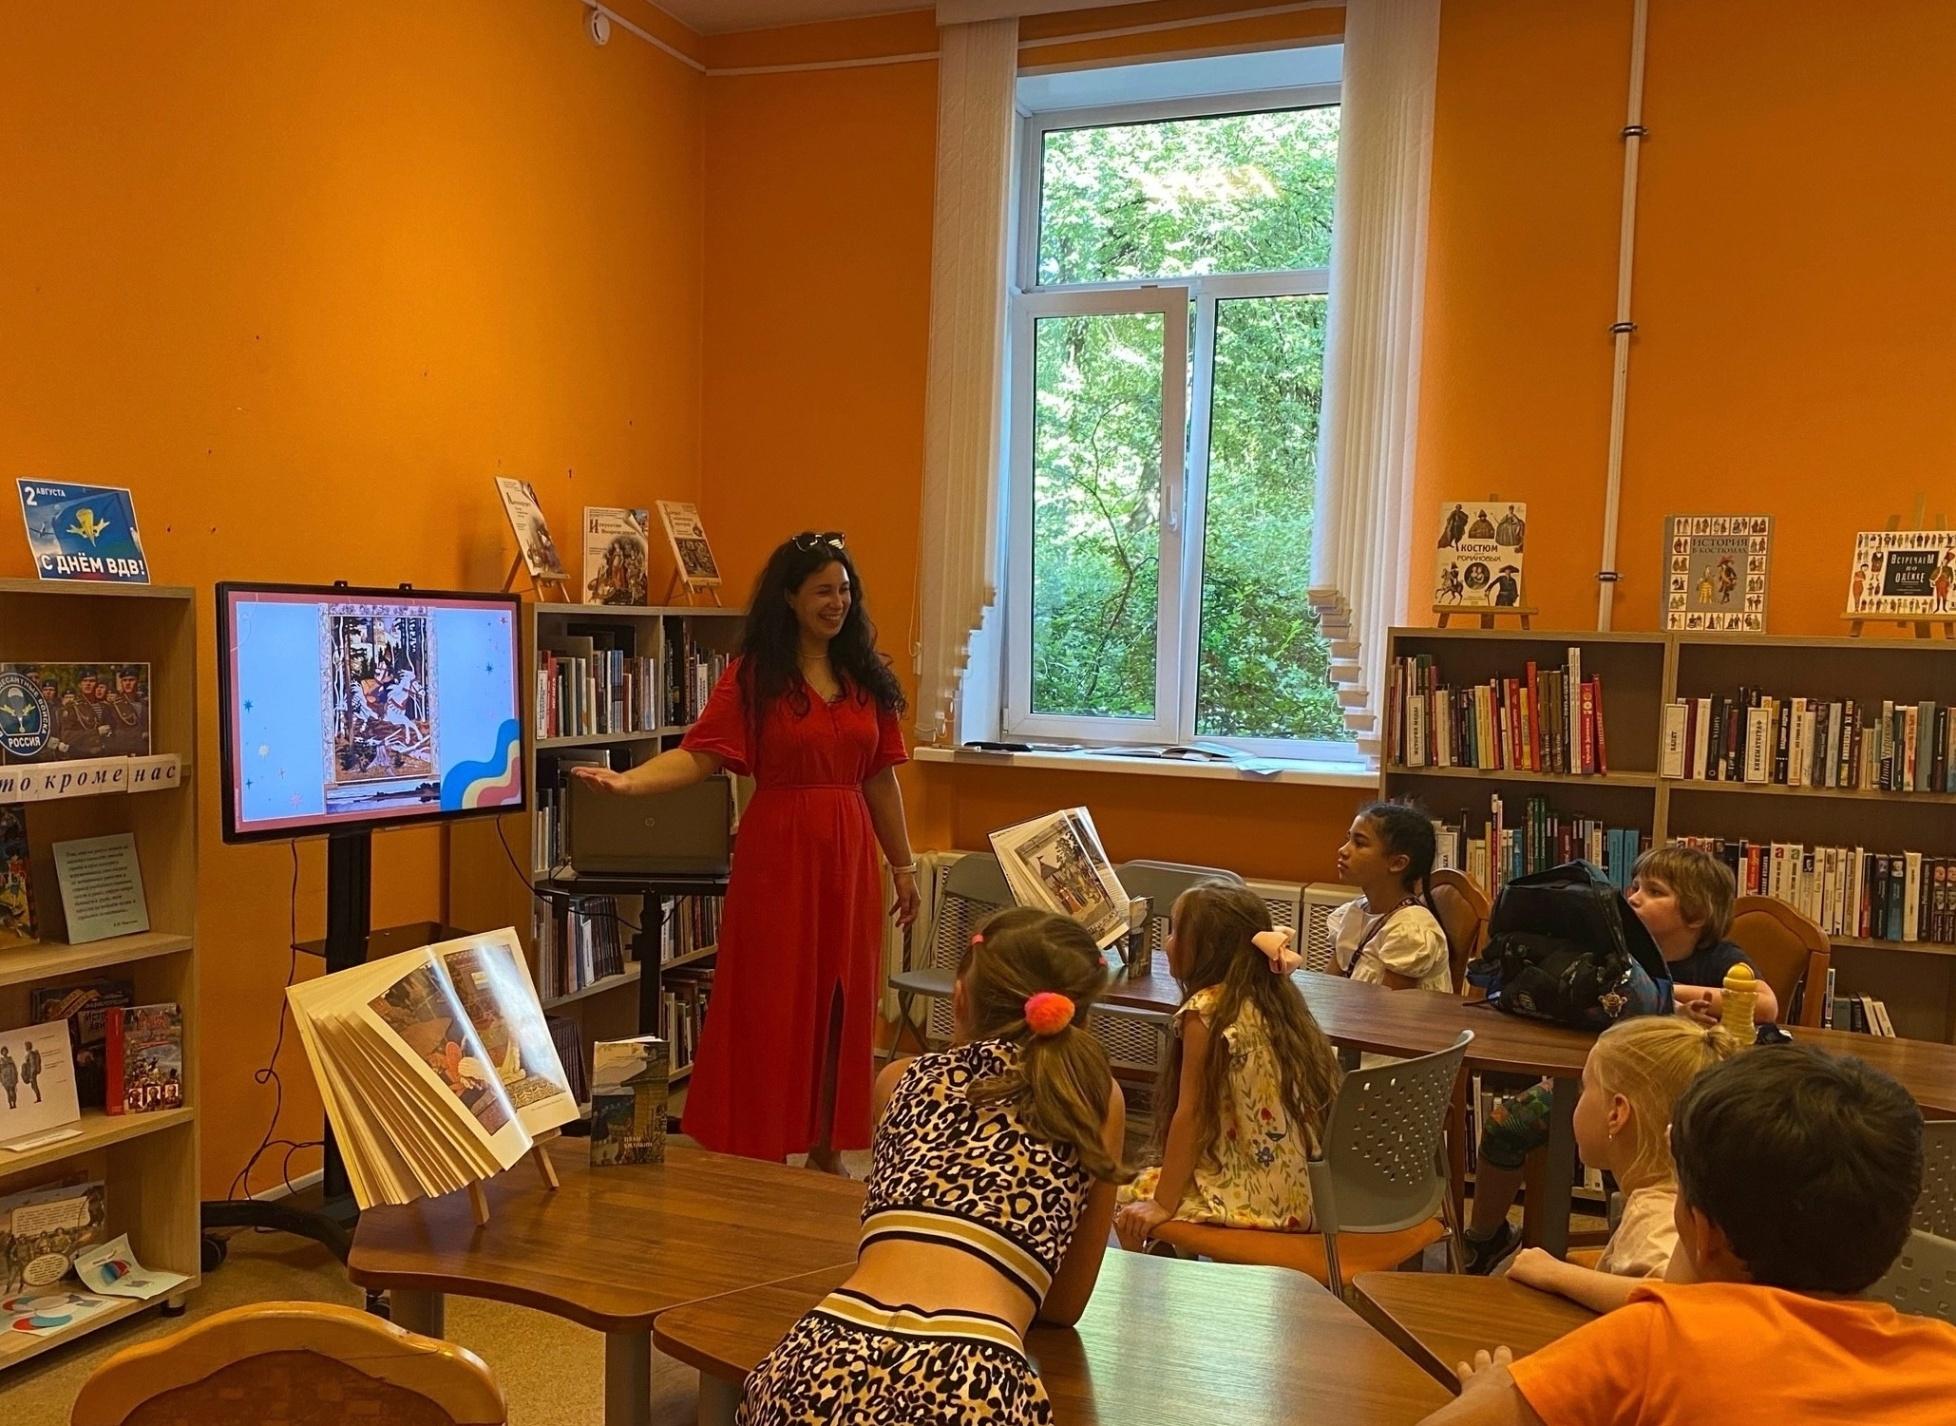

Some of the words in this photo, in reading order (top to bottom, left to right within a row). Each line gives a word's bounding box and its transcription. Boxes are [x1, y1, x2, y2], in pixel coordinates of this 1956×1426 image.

[24, 486, 38, 506] 2
[36, 488, 66, 497] АВГУСТА
[1461, 544, 1498, 552] КОСТЮМ
[1692, 538, 1748, 546] ИСТОРИЯ
[41, 555, 53, 570] С
[56, 552, 105, 574] ДНЁМ
[108, 559, 146, 578] ВДВ!
[8, 736, 41, 748] РОССИЯ
[44, 768, 122, 793] кроме
[134, 764, 176, 782] нас
